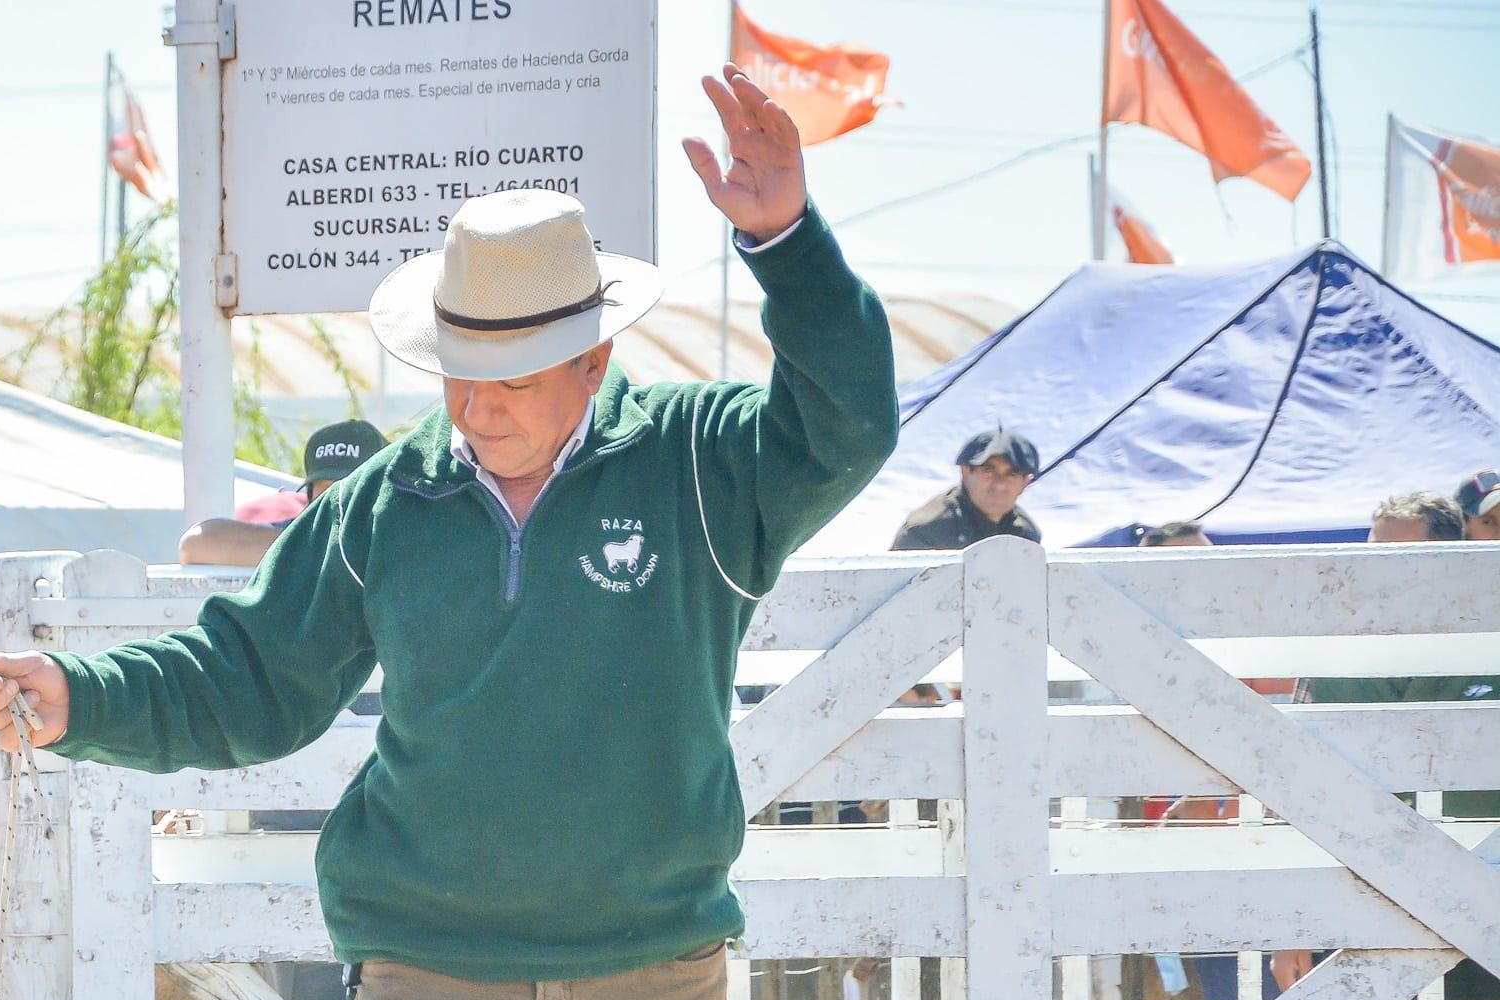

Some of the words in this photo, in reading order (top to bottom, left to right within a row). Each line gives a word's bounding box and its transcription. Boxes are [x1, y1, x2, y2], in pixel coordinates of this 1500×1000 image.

[353, 0, 513, 27] REMATES
[258, 67, 266, 81] Y
[350, 63, 366, 77] de
[370, 61, 400, 76] cada
[440, 56, 497, 72] Remates
[501, 55, 517, 69] de
[522, 50, 584, 68] Hacienda
[588, 48, 629, 64] Gorda
[329, 87, 345, 102] de
[349, 86, 379, 101] cada
[418, 81, 473, 100] Especial
[476, 81, 492, 95] de
[565, 78, 572, 93] y
[284, 157, 337, 175] CASA
[345, 152, 447, 172] CENTRAL:
[455, 146, 490, 167] RÍO
[498, 145, 584, 165] CUARTO
[286, 186, 373, 206] ALBERDI
[381, 185, 417, 202] 633
[313, 217, 429, 237] SUCURSAL:
[267, 247, 336, 270] COLÓN
[345, 250, 380, 267] 344
[315, 442, 360, 459] GRCN
[600, 518, 643, 531] RAZA
[578, 554, 631, 592] HAMPSHIRE
[635, 553, 659, 587] DOWN
